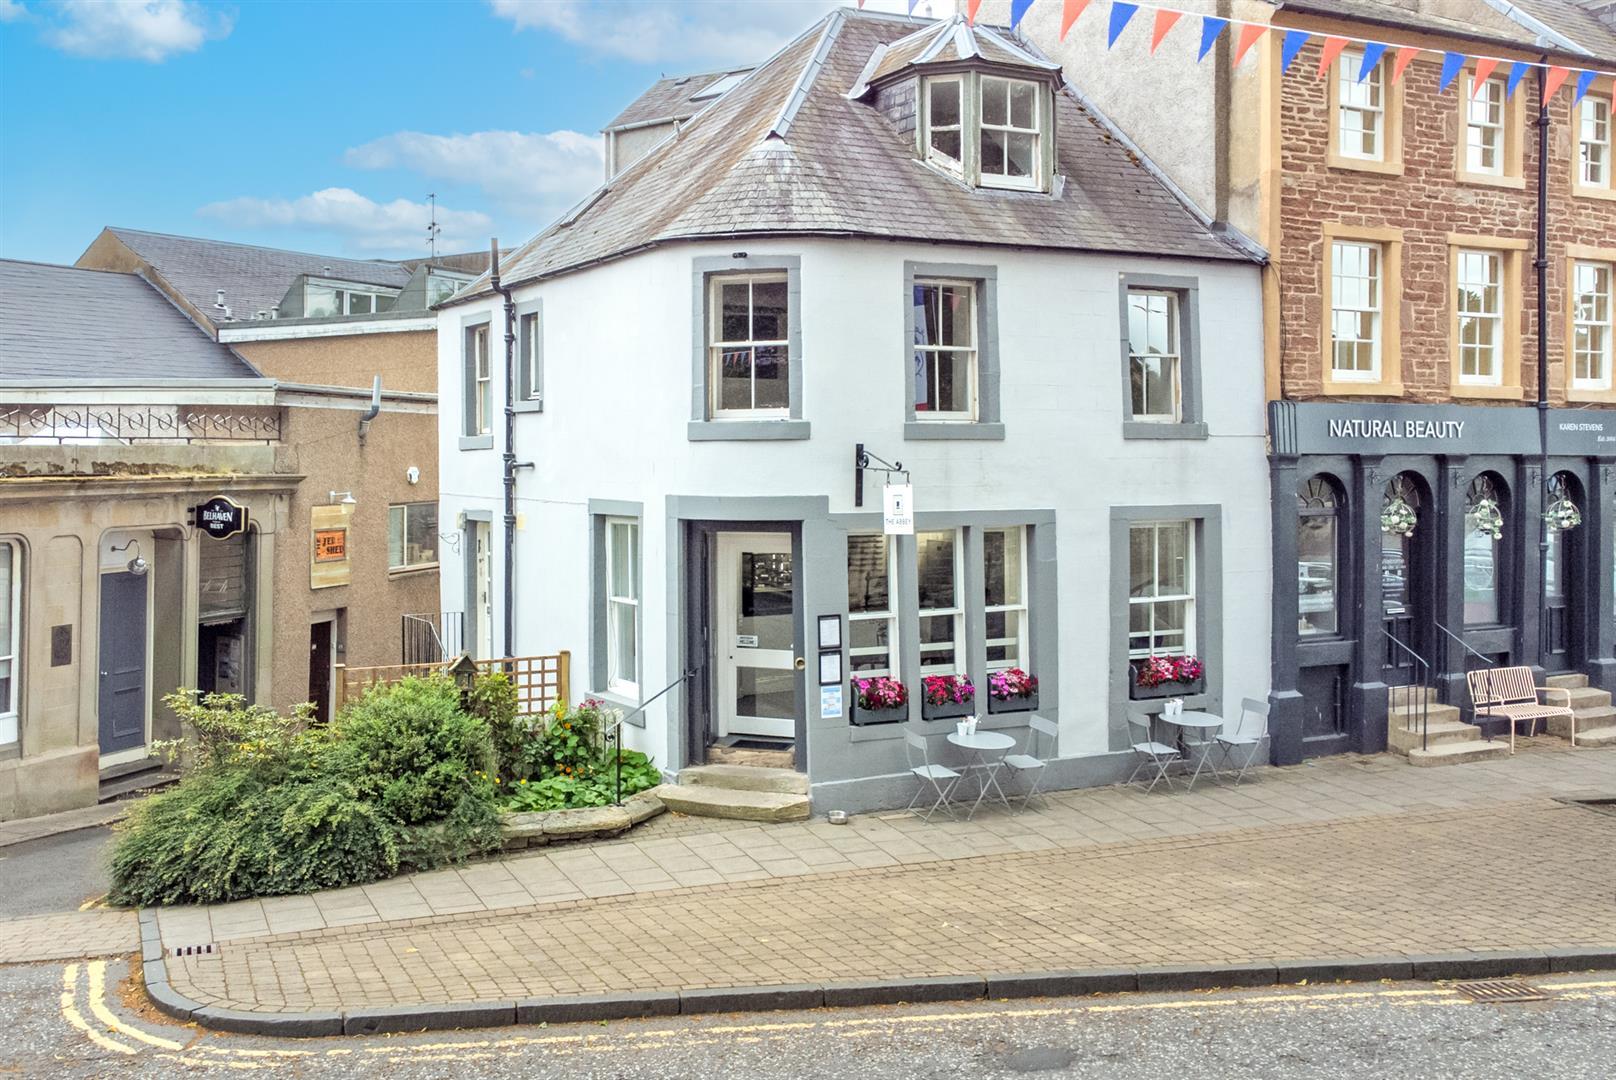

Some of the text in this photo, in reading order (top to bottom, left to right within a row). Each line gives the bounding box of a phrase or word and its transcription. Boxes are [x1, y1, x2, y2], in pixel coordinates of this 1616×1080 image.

[1328, 419, 1465, 438] NATURAL BEAUTY
[1559, 423, 1604, 431] KAREN STEVENS
[203, 510, 233, 522] BELHAVEN
[885, 518, 911, 526] THE ABBEY
[326, 545, 344, 555] SHED
